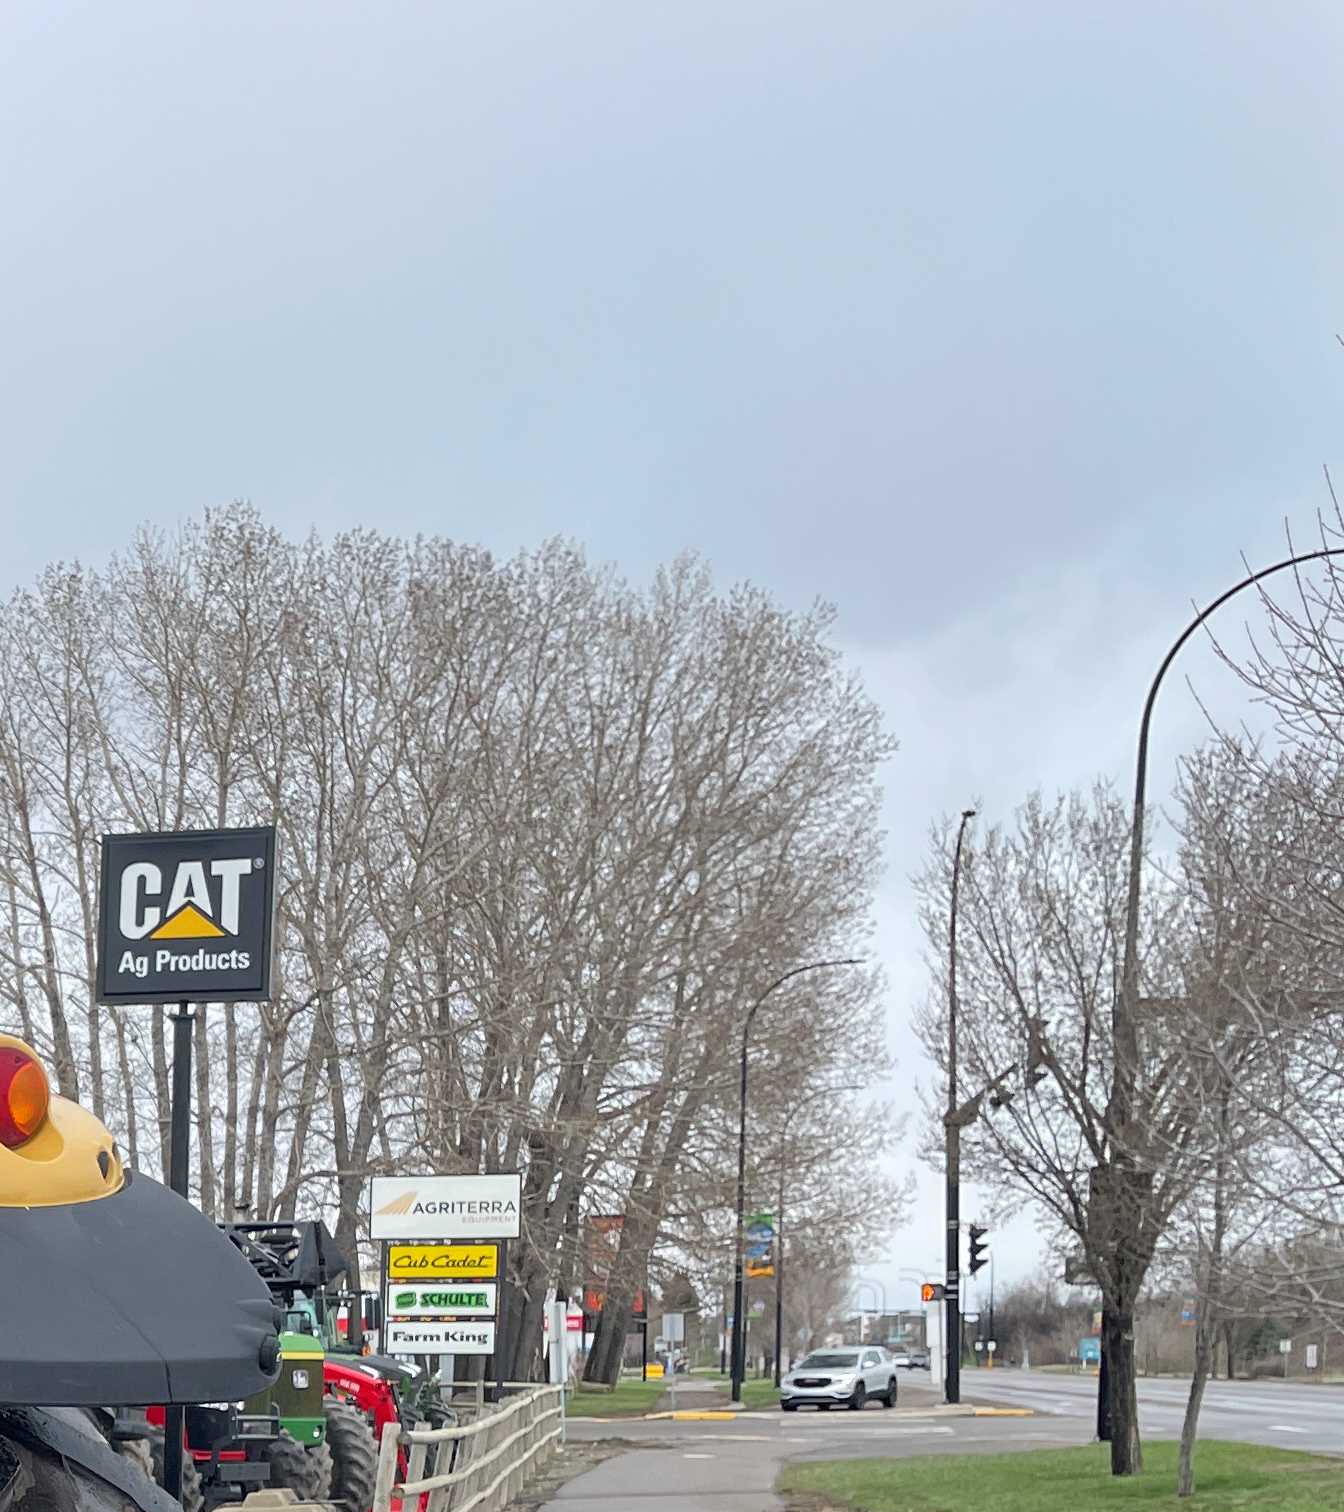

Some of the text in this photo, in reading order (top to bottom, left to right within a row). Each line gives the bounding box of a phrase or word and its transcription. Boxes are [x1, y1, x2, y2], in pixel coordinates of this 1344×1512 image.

[119, 859, 252, 940] CAT
[118, 949, 250, 978] Ag Products
[412, 1200, 516, 1214] AGRITERRA
[393, 1254, 493, 1268] Cub Cadet
[419, 1292, 489, 1308] SCHULTE
[392, 1331, 489, 1344] Farm King
